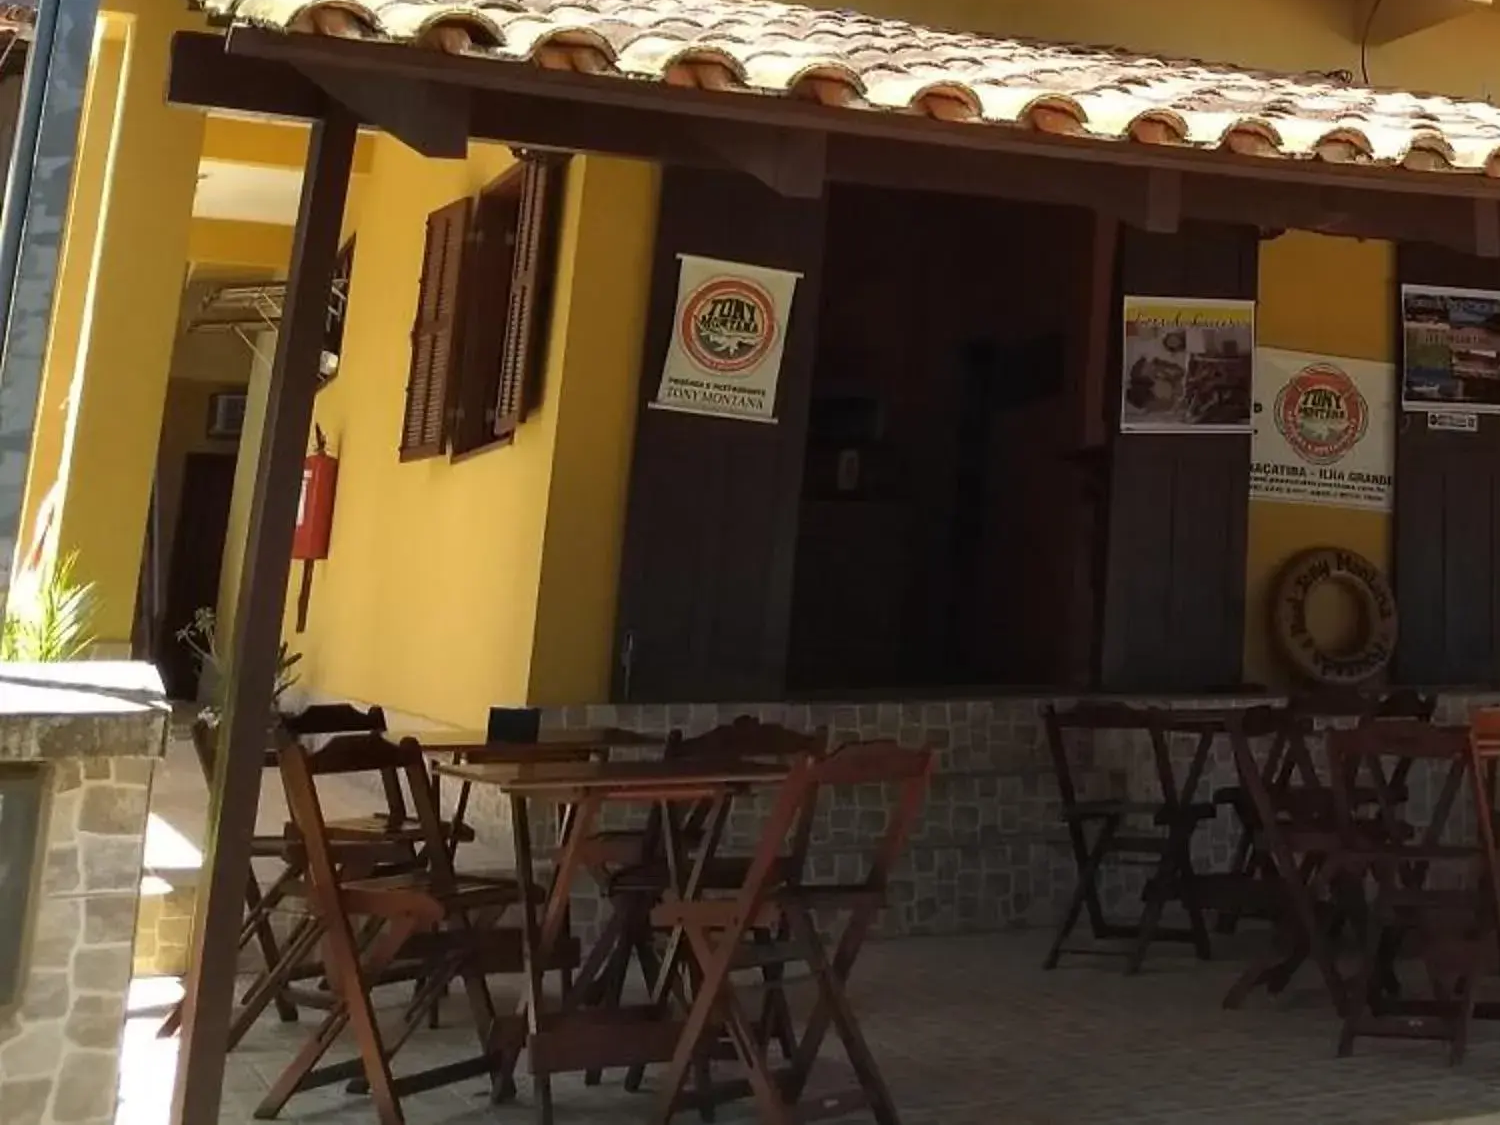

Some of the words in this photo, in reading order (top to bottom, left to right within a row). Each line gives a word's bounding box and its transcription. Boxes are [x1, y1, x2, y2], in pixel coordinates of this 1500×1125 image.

[709, 298, 757, 321] TONY
[667, 387, 701, 401] TONY
[702, 391, 764, 409] MONTANA
[1302, 389, 1342, 409] TONY
[1320, 468, 1345, 481] ILHA
